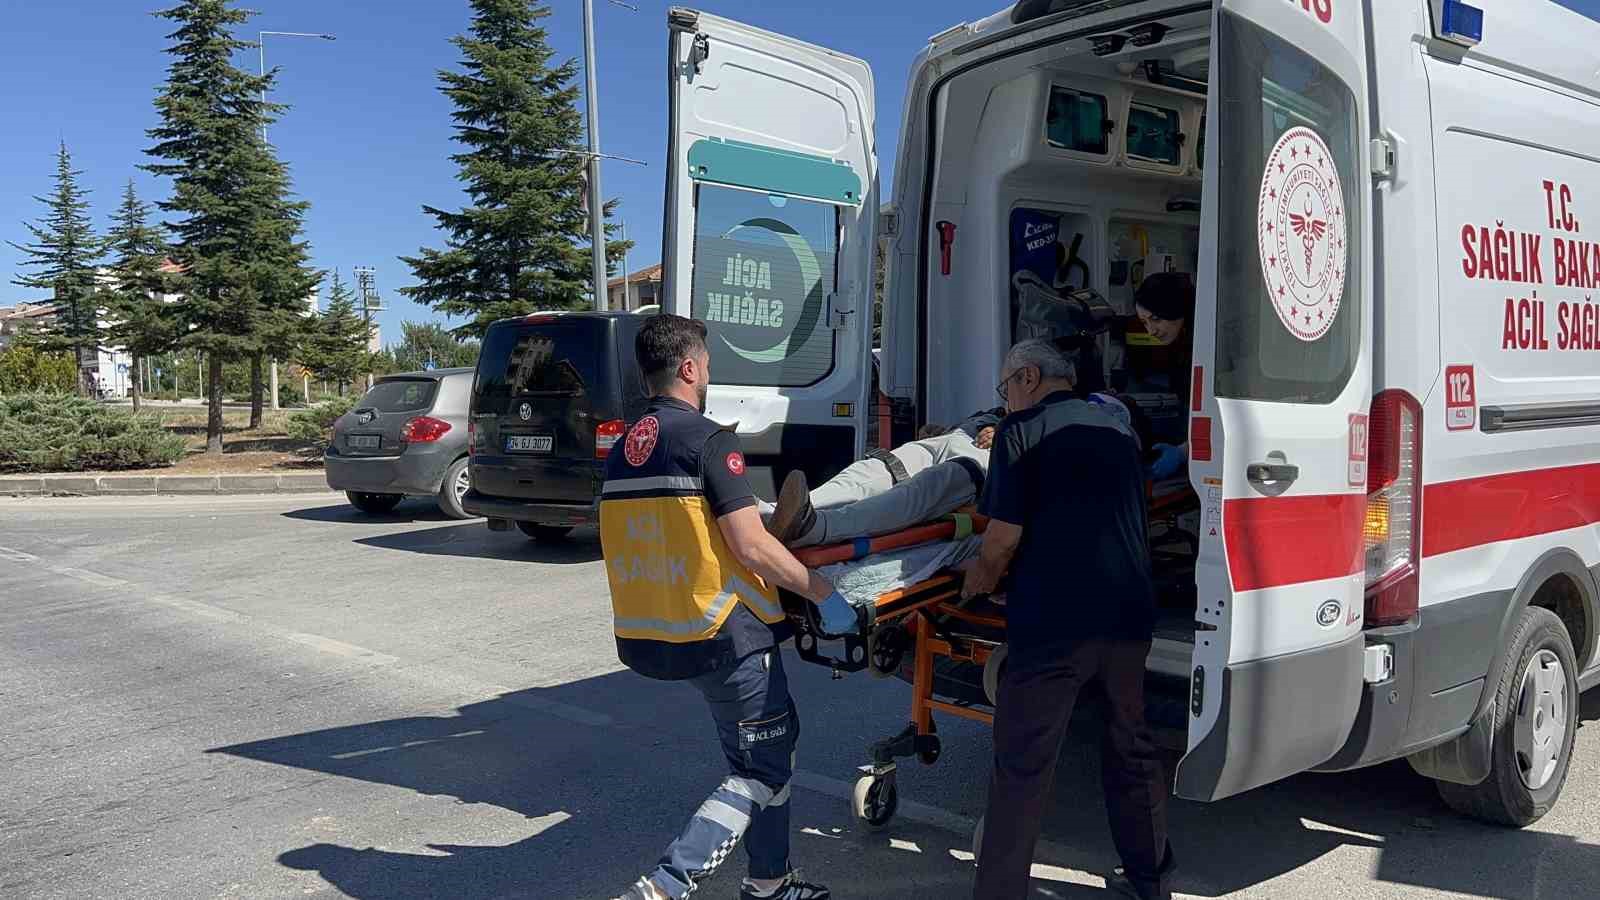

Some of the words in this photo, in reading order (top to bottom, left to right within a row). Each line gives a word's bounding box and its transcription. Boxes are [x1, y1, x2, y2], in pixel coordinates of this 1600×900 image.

[1543, 180, 1579, 232] T.C.
[1461, 219, 1543, 284] SAĞLIK
[1502, 290, 1549, 350] ACİL
[1449, 372, 1472, 402] 112
[1352, 423, 1366, 456] 112
